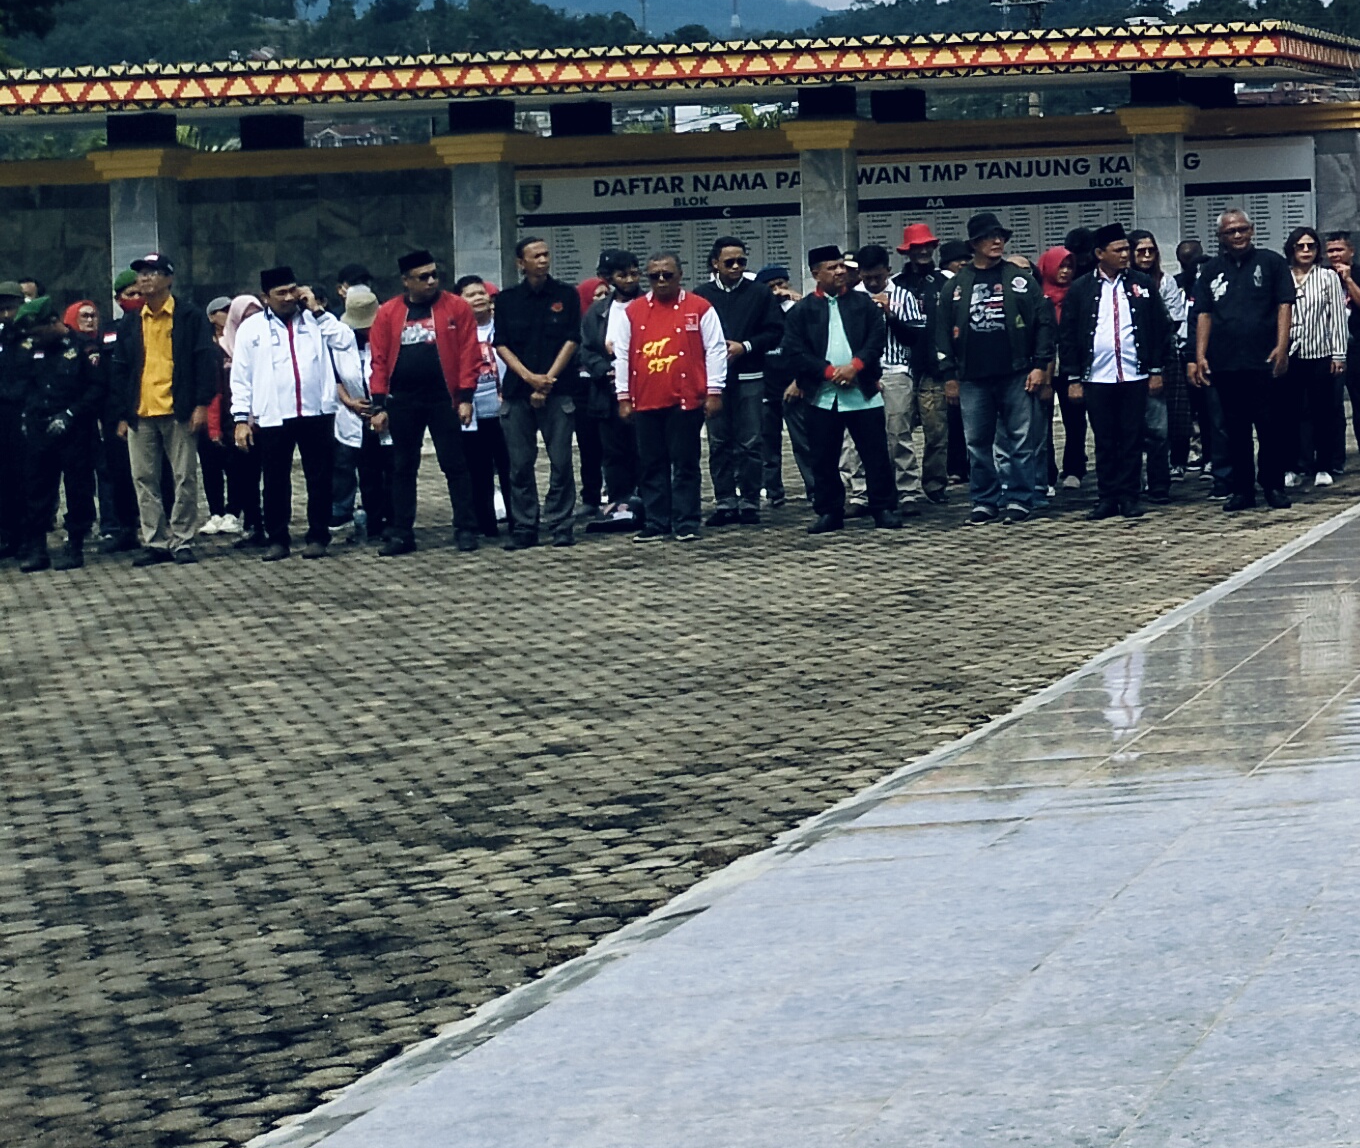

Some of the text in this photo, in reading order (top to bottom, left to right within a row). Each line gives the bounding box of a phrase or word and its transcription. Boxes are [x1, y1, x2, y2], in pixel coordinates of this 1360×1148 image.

[593, 175, 685, 198] DAFTAR
[692, 171, 768, 193] NAMA
[919, 163, 968, 183] TMP
[975, 157, 1091, 180] TANJUNG
[1088, 177, 1125, 188] BLOK
[673, 195, 709, 207] BLOK
[926, 198, 945, 208] AA
[722, 207, 731, 217] C
[647, 355, 679, 375] SET
